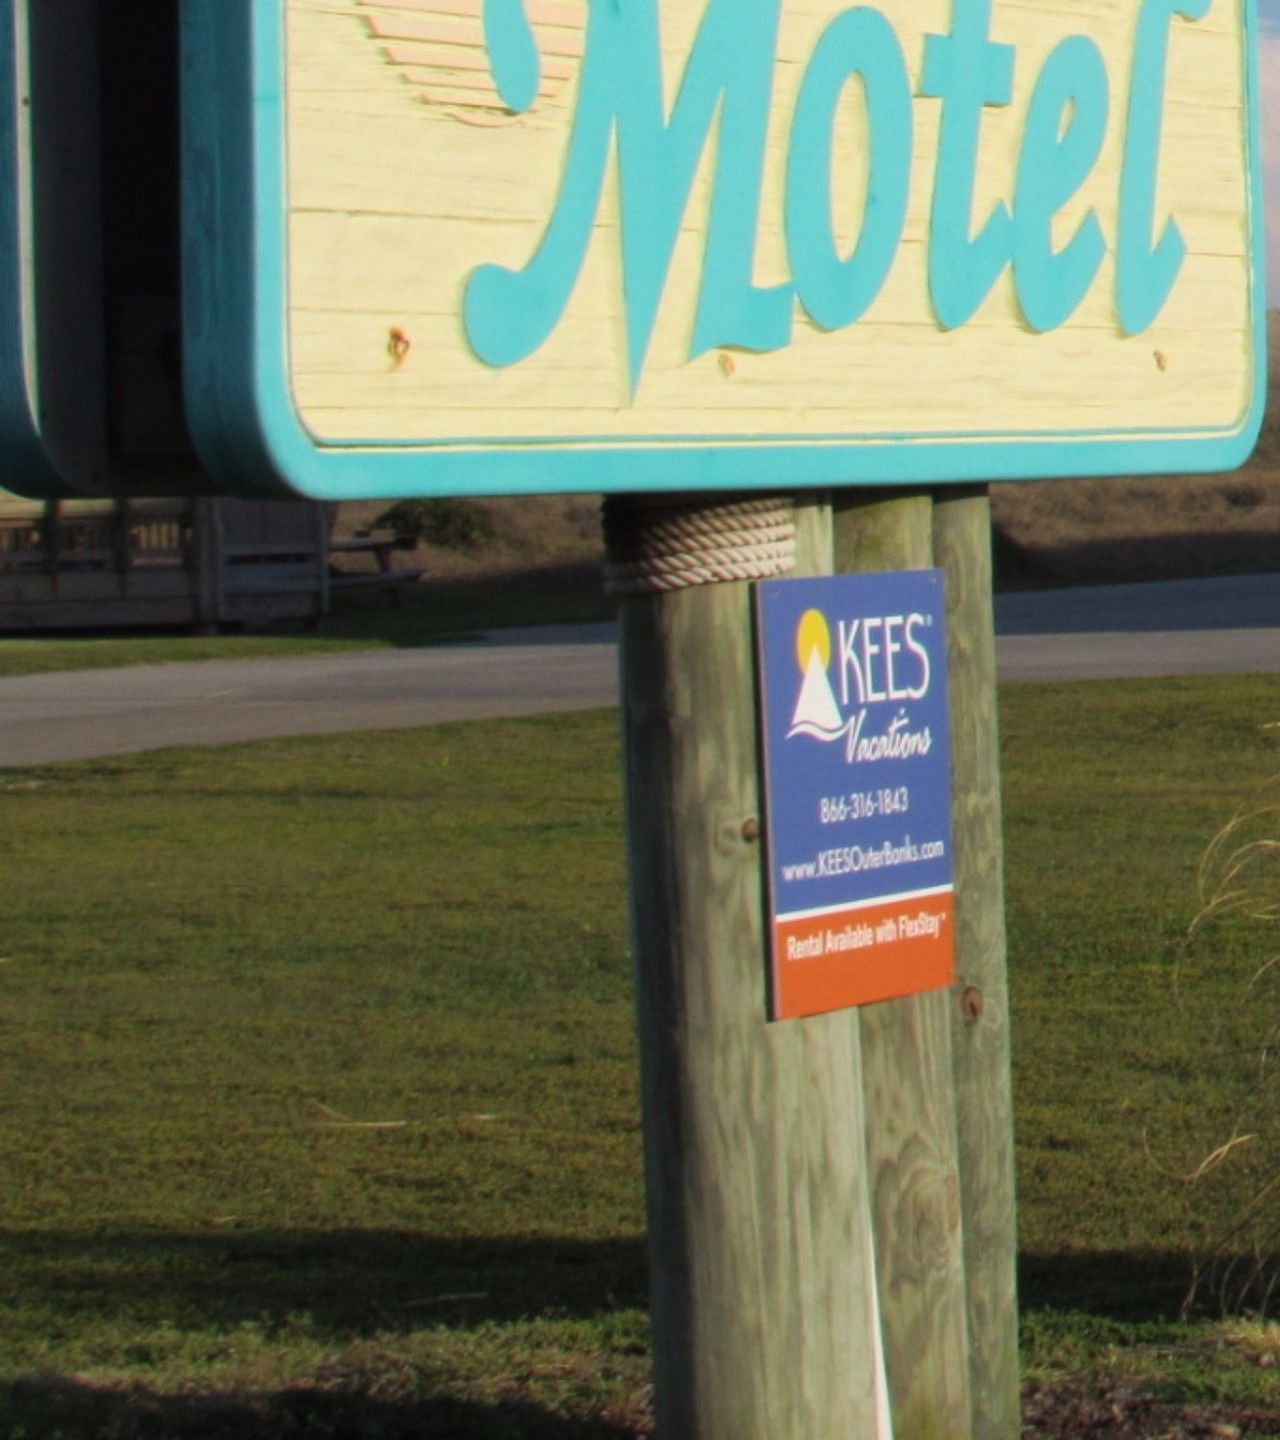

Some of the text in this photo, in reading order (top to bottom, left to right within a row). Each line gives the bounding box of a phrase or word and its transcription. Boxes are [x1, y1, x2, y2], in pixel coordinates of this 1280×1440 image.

[838, 613, 931, 706] KEES
[844, 708, 932, 764] Vacations
[820, 786, 909, 824] 866-316-1843
[782, 834, 945, 882] www.KEESOuterBanks.com
[787, 931, 823, 960] Rental
[825, 922, 874, 953] Available
[876, 918, 897, 944] with
